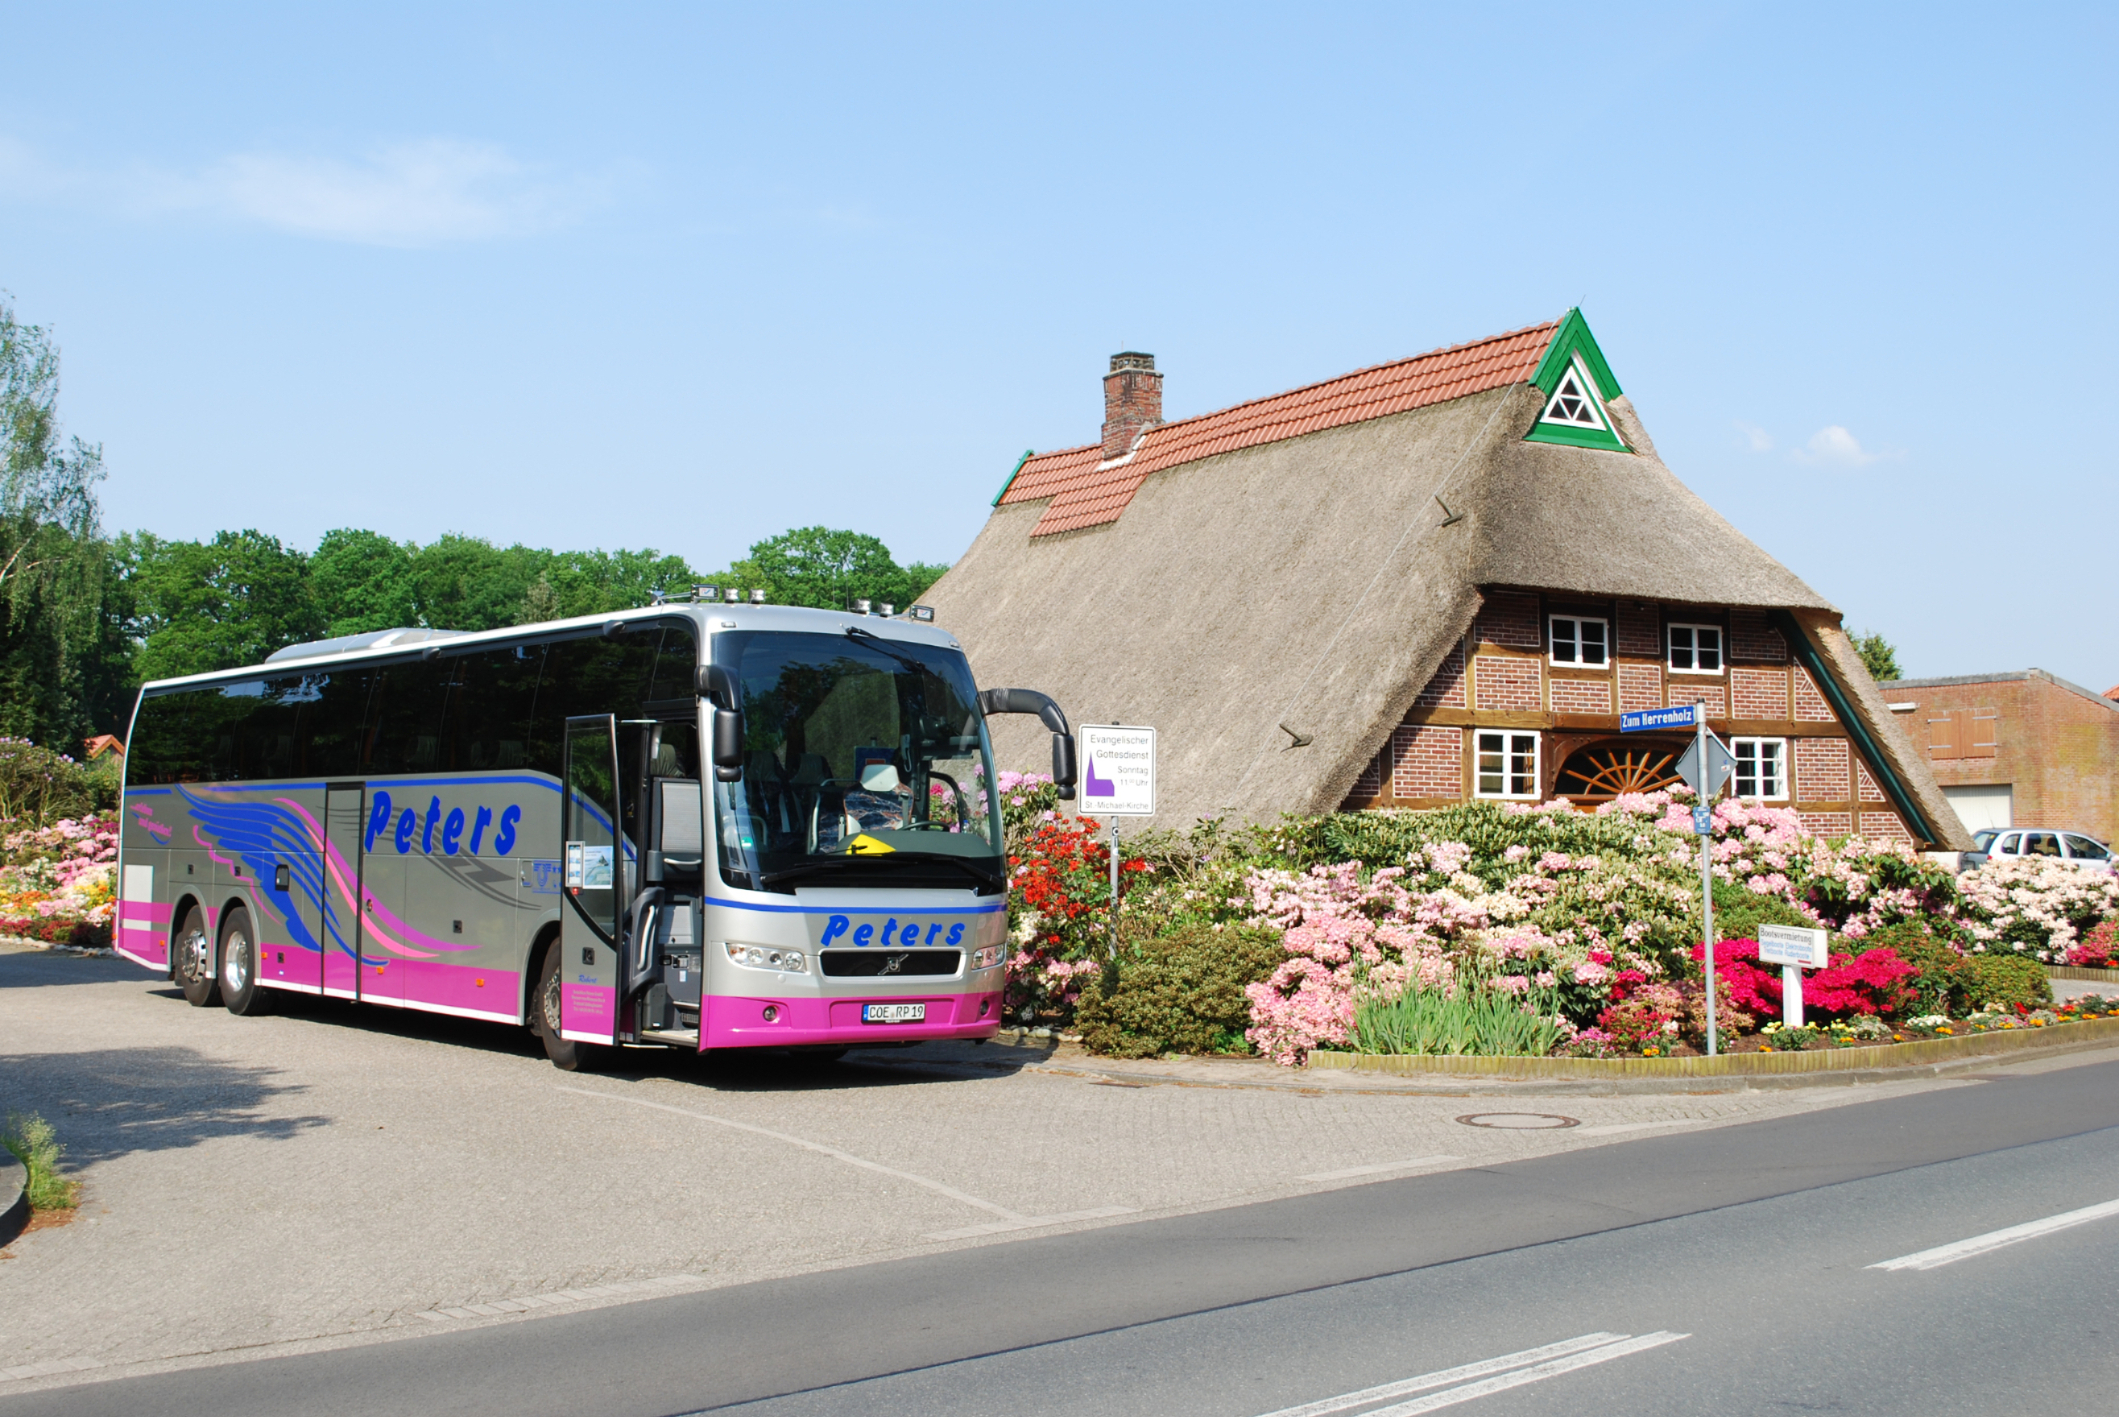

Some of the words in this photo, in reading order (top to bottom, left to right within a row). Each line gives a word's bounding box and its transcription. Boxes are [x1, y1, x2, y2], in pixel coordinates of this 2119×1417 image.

[1622, 715, 1640, 728] Zum
[1642, 708, 1692, 726] Herrenholz
[1090, 734, 1148, 746] Evangelischer
[1096, 749, 1148, 759] Gottesdienst
[1117, 765, 1148, 776] Sonntag
[1085, 800, 1149, 810] St.-Michael-Kirche
[364, 790, 522, 856] Peters
[820, 914, 965, 947] Peters
[1760, 927, 1812, 945] Bootsvermietung
[869, 1006, 889, 1018] COE
[896, 1006, 910, 1018] RP
[911, 1005, 924, 1018] 19
